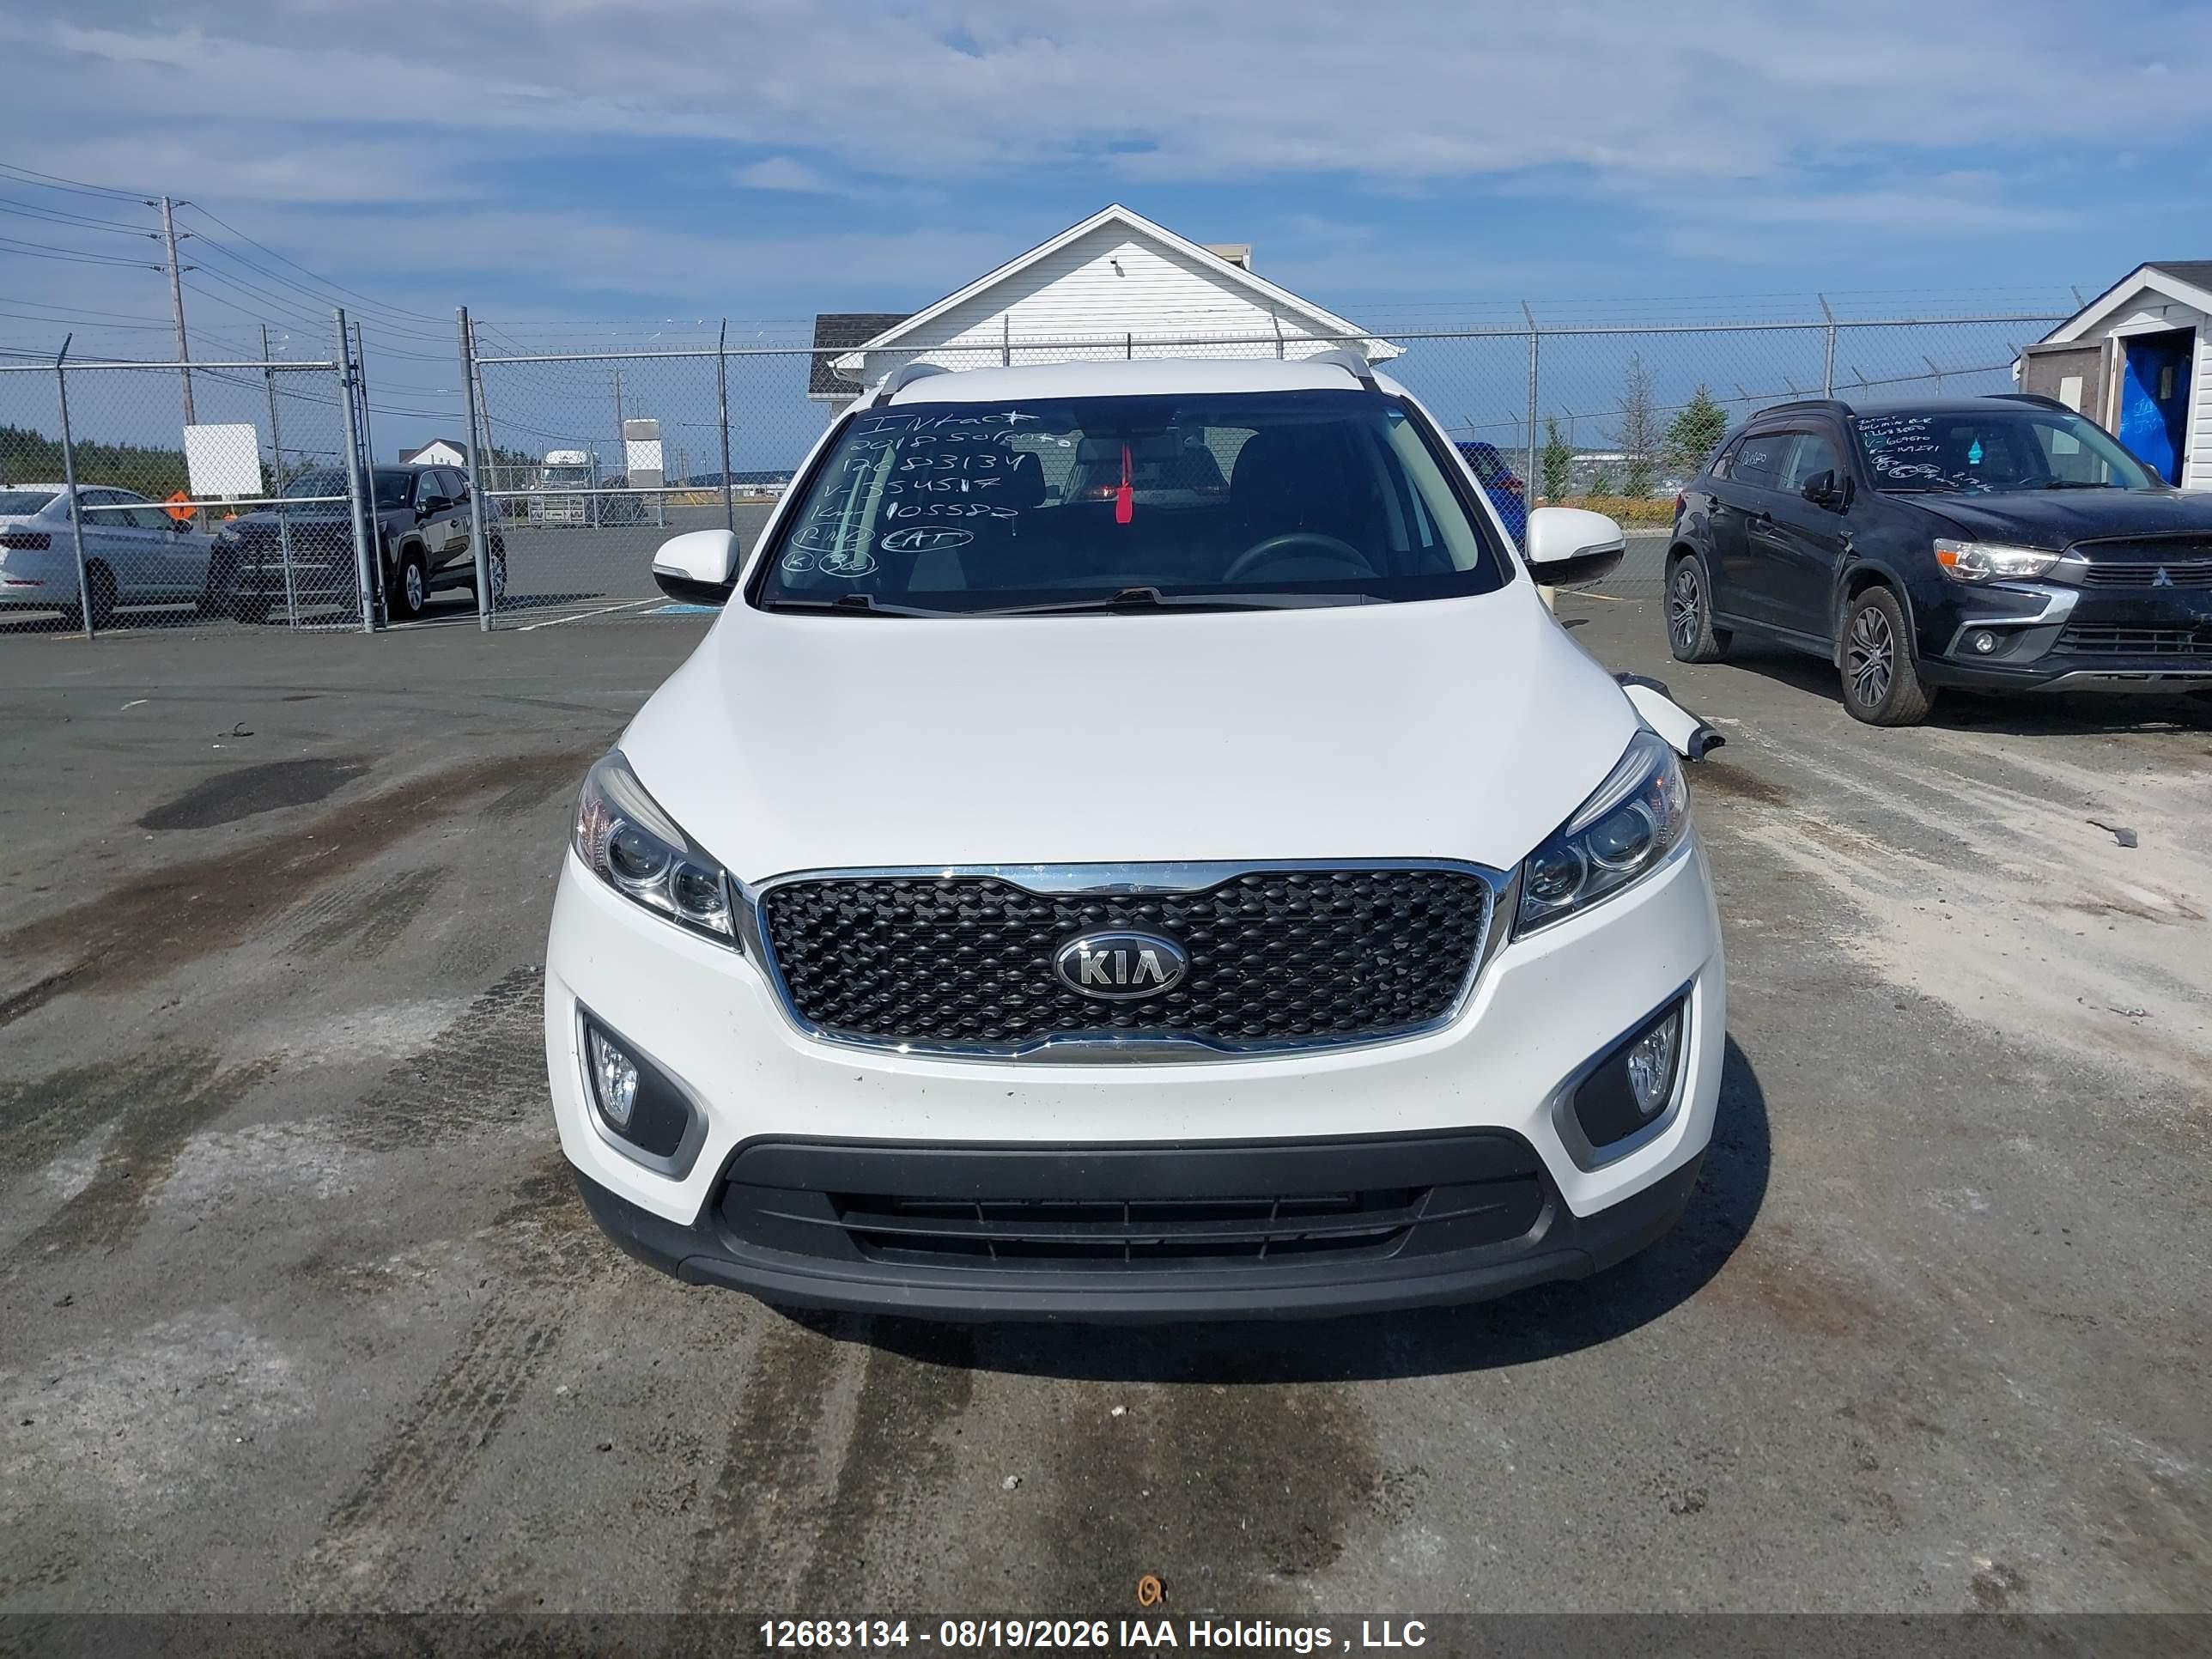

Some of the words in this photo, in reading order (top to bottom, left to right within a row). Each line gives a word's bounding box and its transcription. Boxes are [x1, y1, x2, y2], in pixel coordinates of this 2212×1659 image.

[850, 436, 938, 452] 2018
[843, 454, 1026, 472] 12683134
[1079, 950, 1164, 984] KIA
